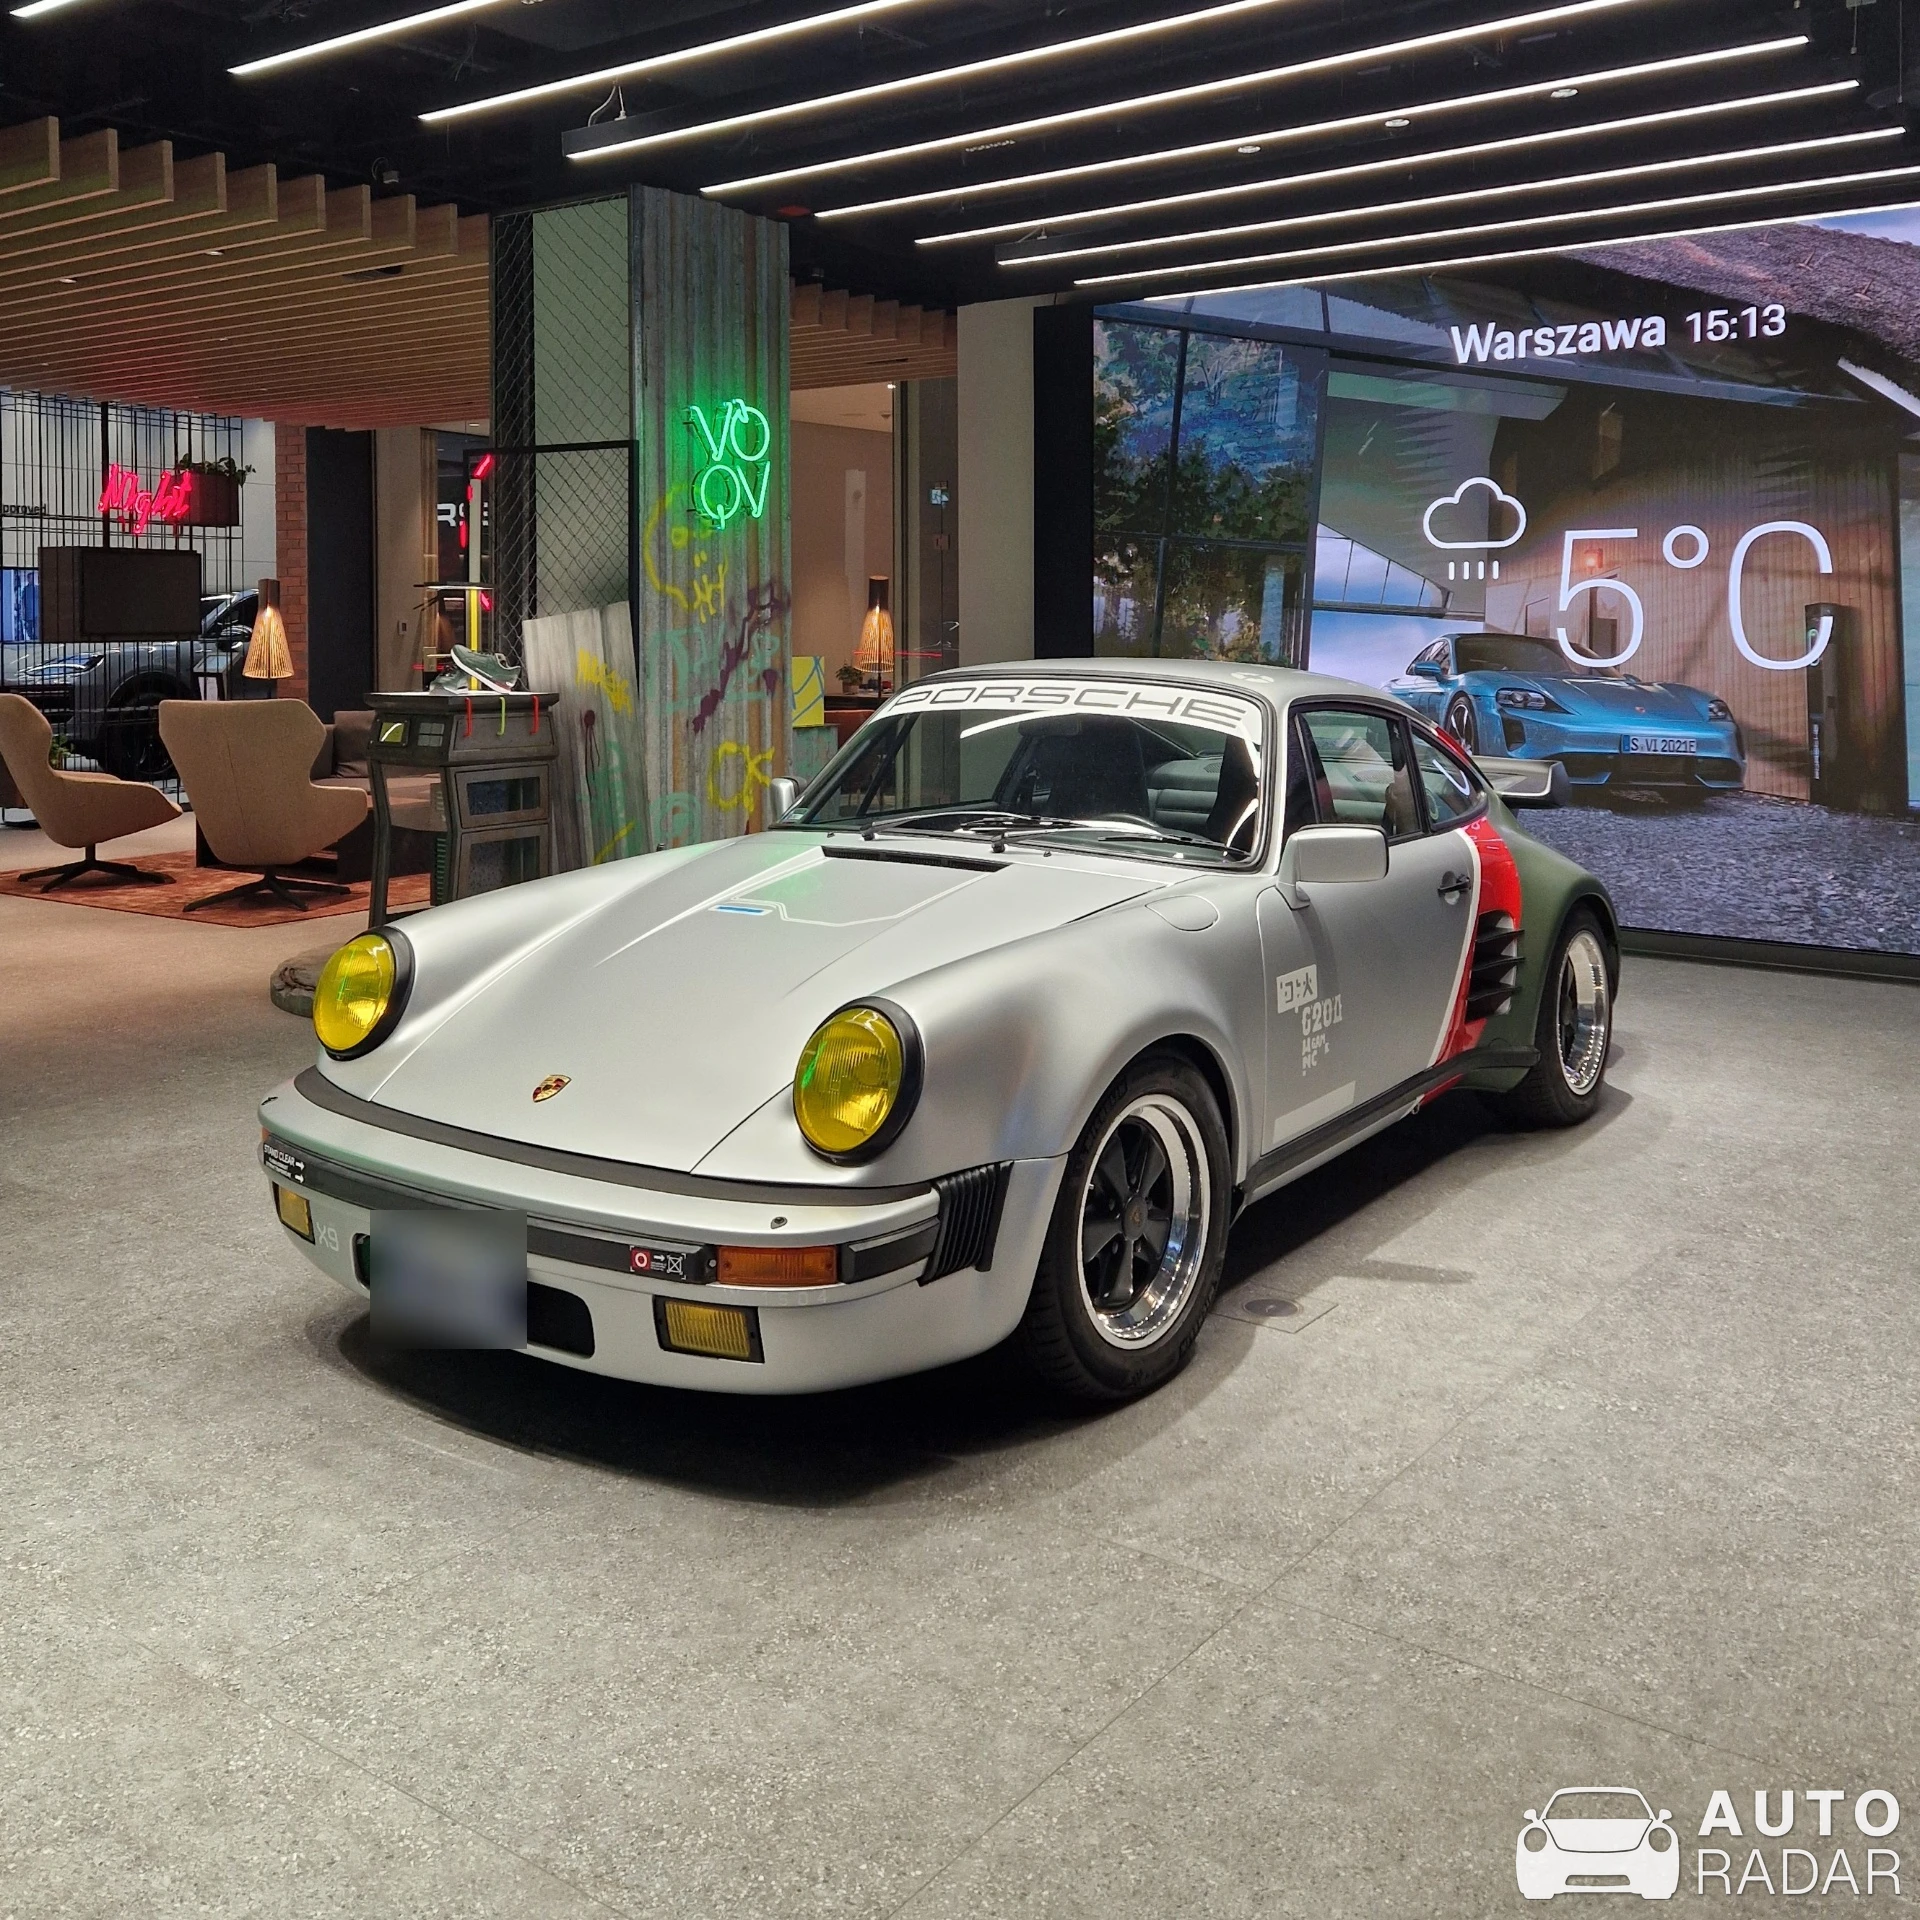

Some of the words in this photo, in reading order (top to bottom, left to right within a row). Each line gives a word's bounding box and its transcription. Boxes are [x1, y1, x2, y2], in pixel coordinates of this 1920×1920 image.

[1450, 314, 1666, 364] Warszawa
[1685, 303, 1787, 343] 15:13
[1557, 520, 1834, 670] 5°C
[887, 685, 1247, 729] PORSCHE
[279, 1151, 296, 1167] CLEAR
[316, 1221, 340, 1252] X9
